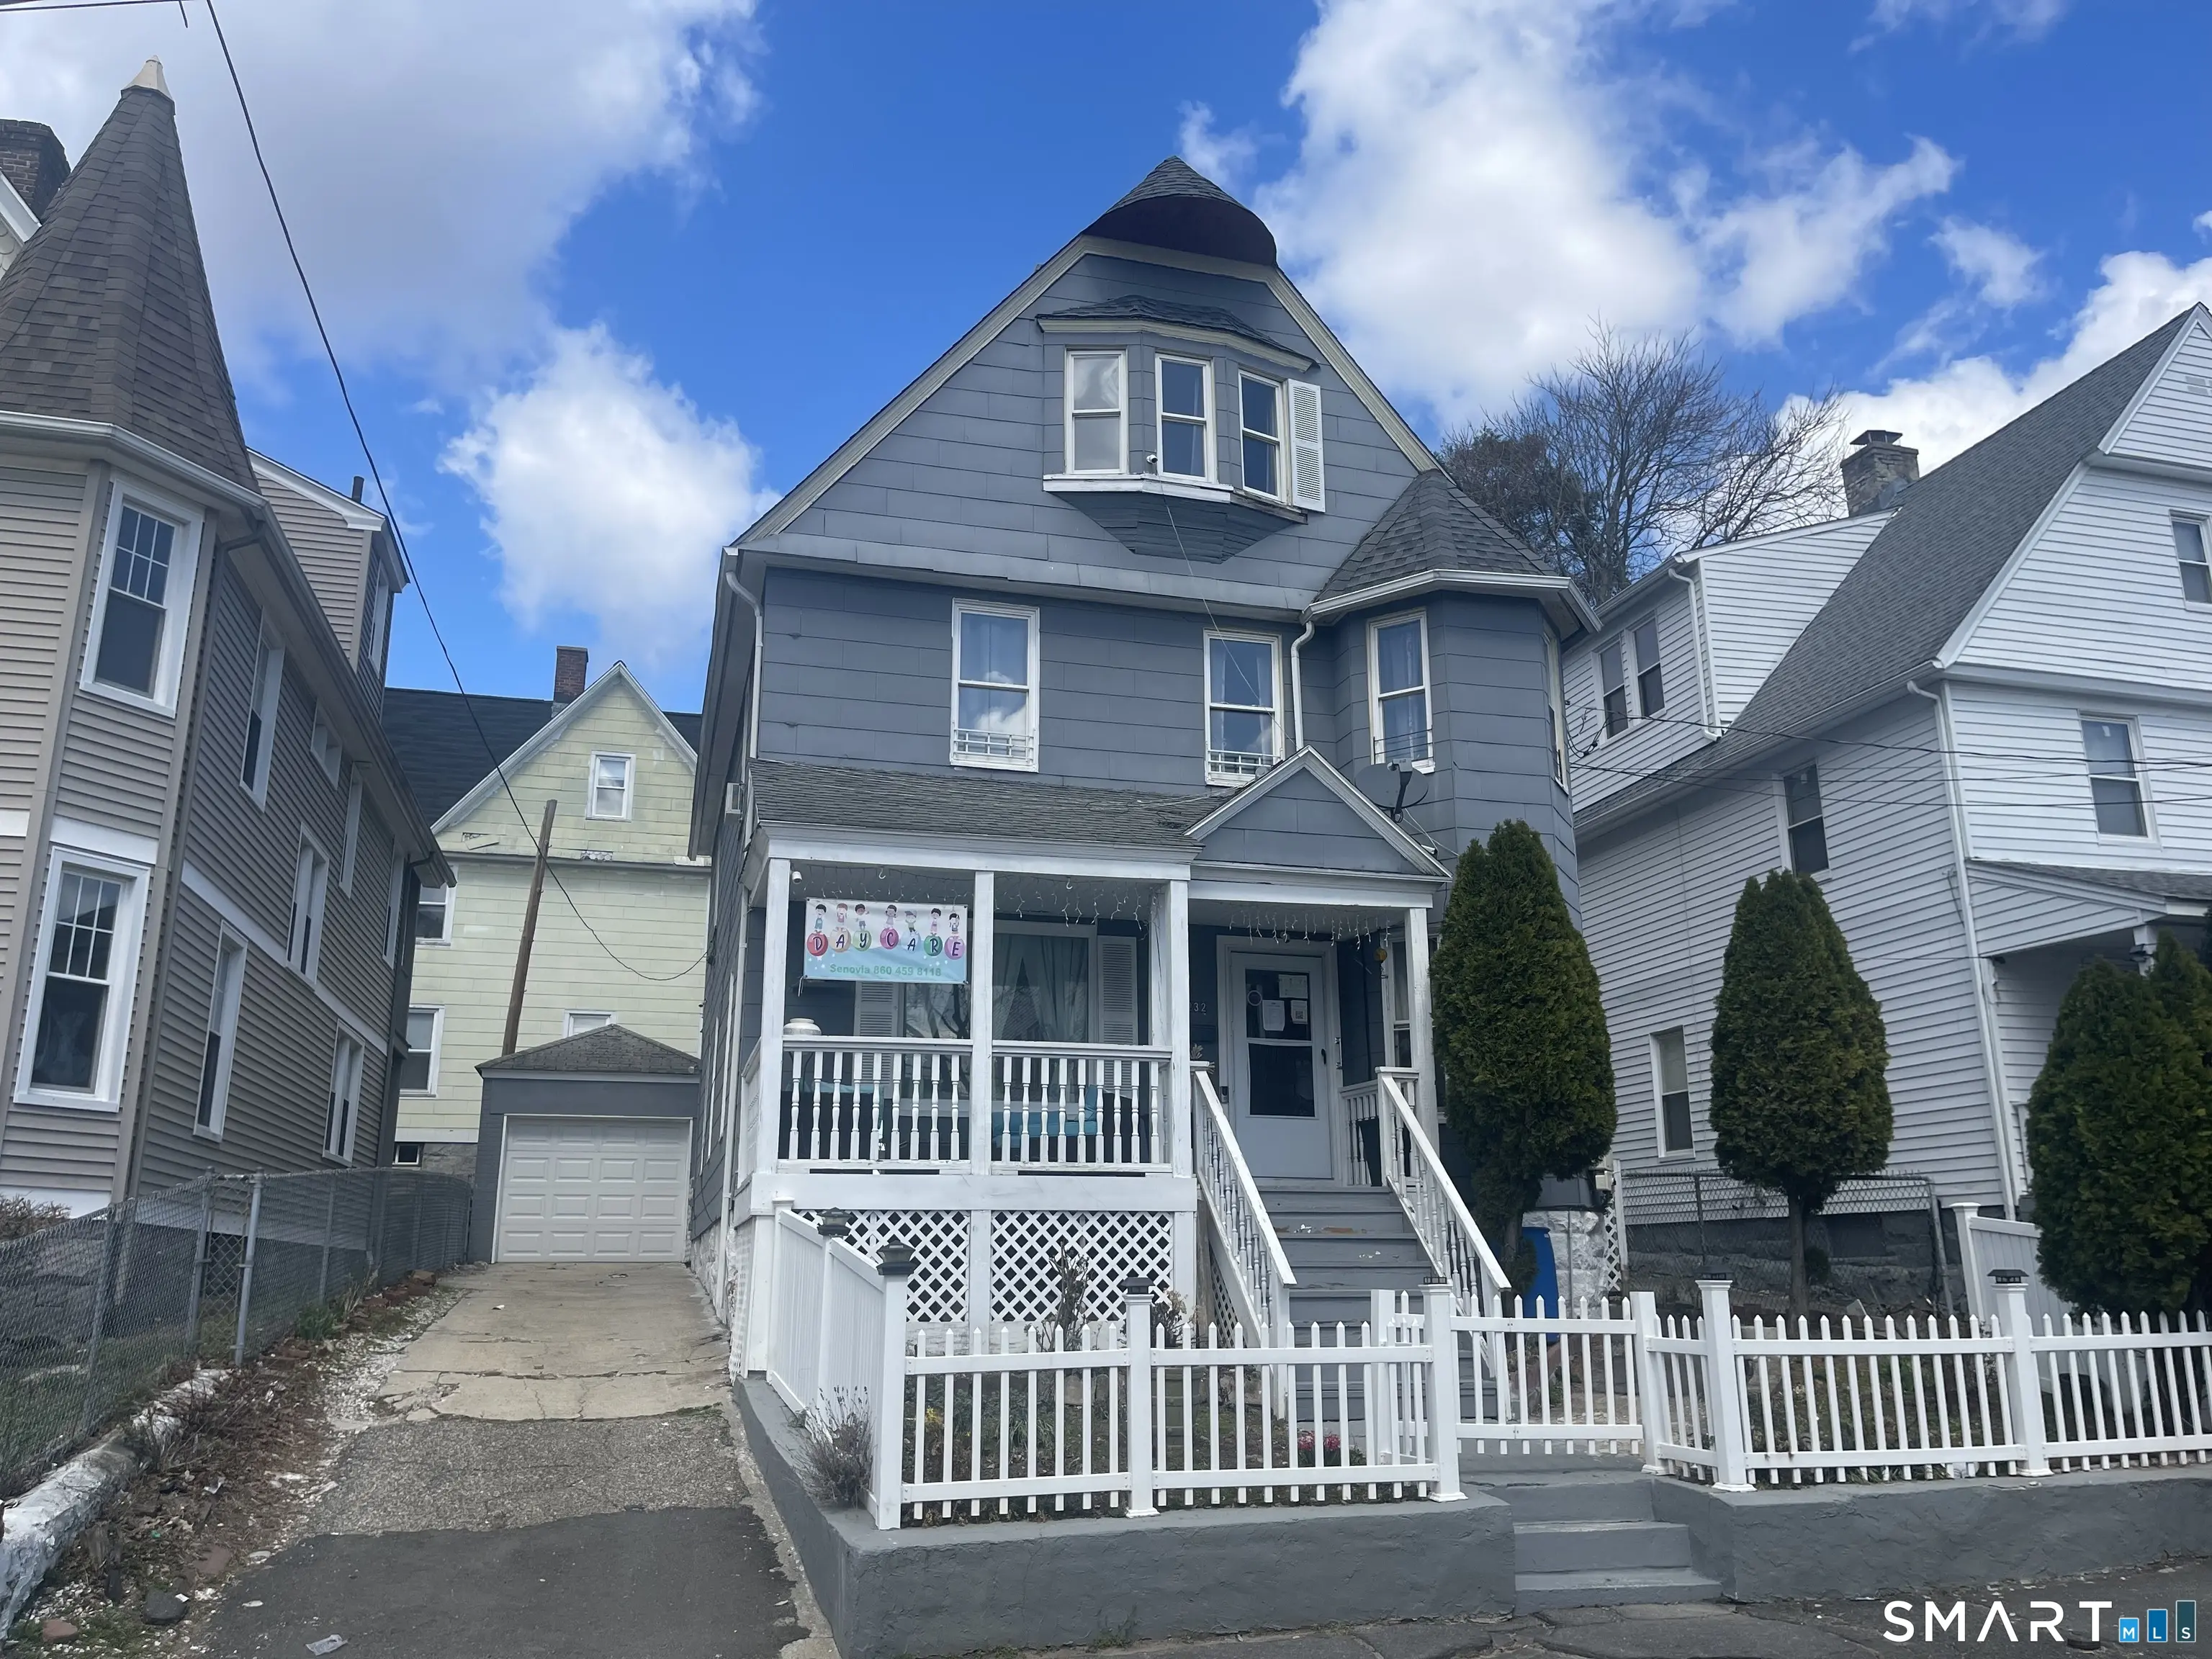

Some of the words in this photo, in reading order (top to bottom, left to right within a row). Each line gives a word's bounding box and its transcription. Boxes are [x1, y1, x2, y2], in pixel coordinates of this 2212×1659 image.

[830, 964, 871, 974] Senovia
[873, 966, 892, 975] 860
[896, 966, 914, 976] 459
